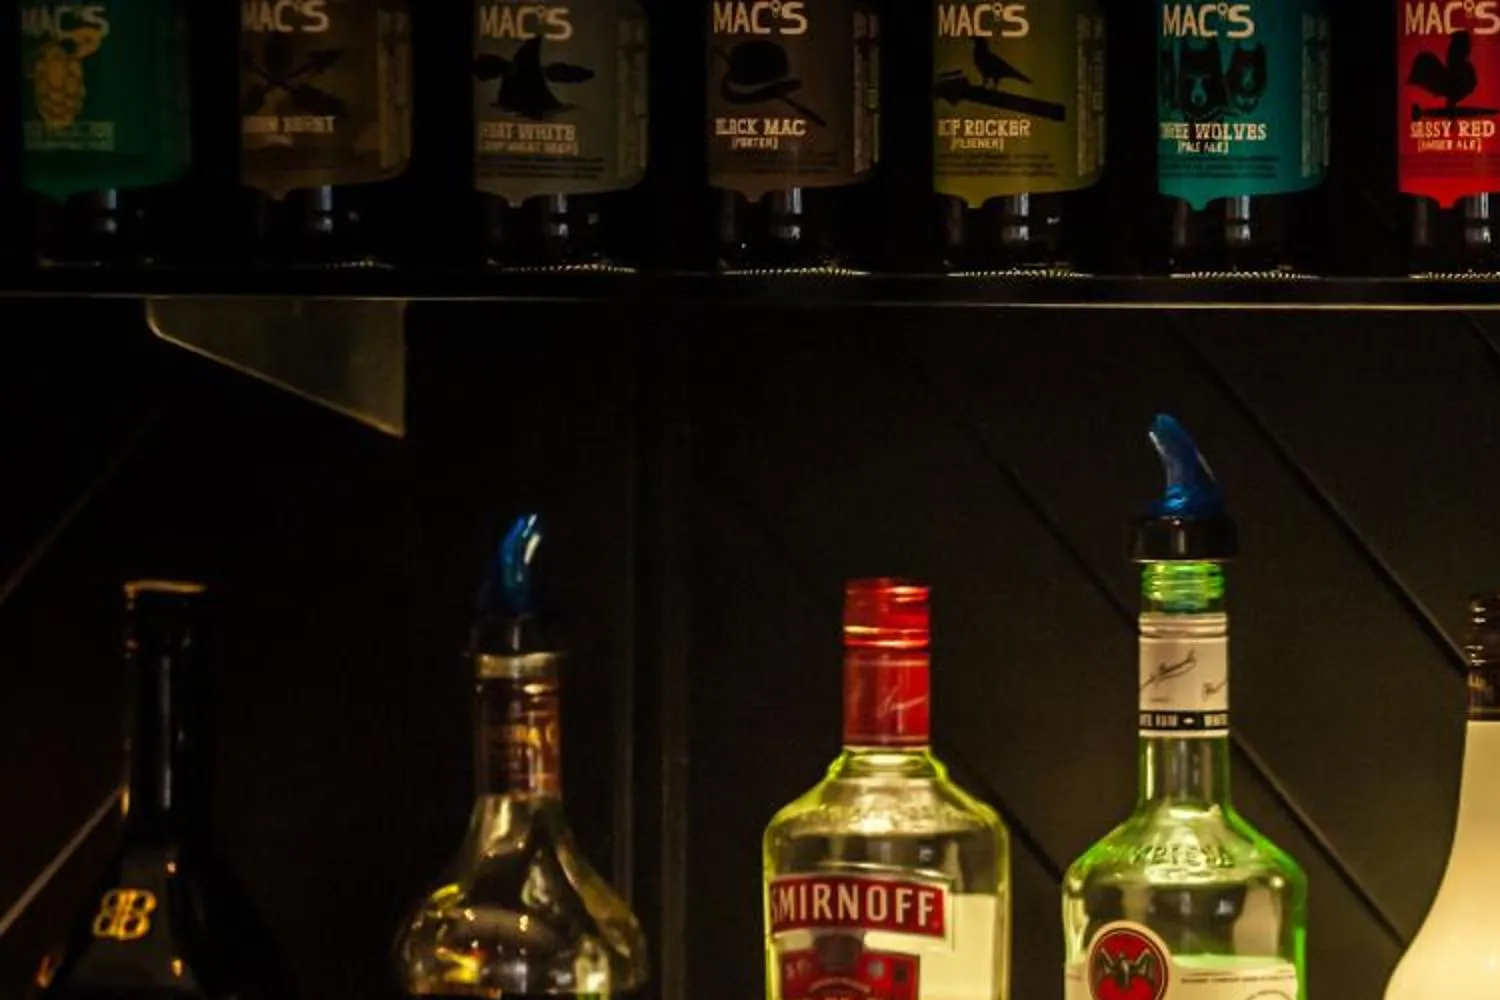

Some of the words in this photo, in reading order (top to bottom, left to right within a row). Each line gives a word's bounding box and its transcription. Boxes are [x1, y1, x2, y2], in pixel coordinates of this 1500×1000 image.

[763, 118, 806, 136] MAC
[964, 119, 1032, 137] ROCKER
[1194, 123, 1268, 141] WOLVES
[1457, 120, 1496, 137] RED
